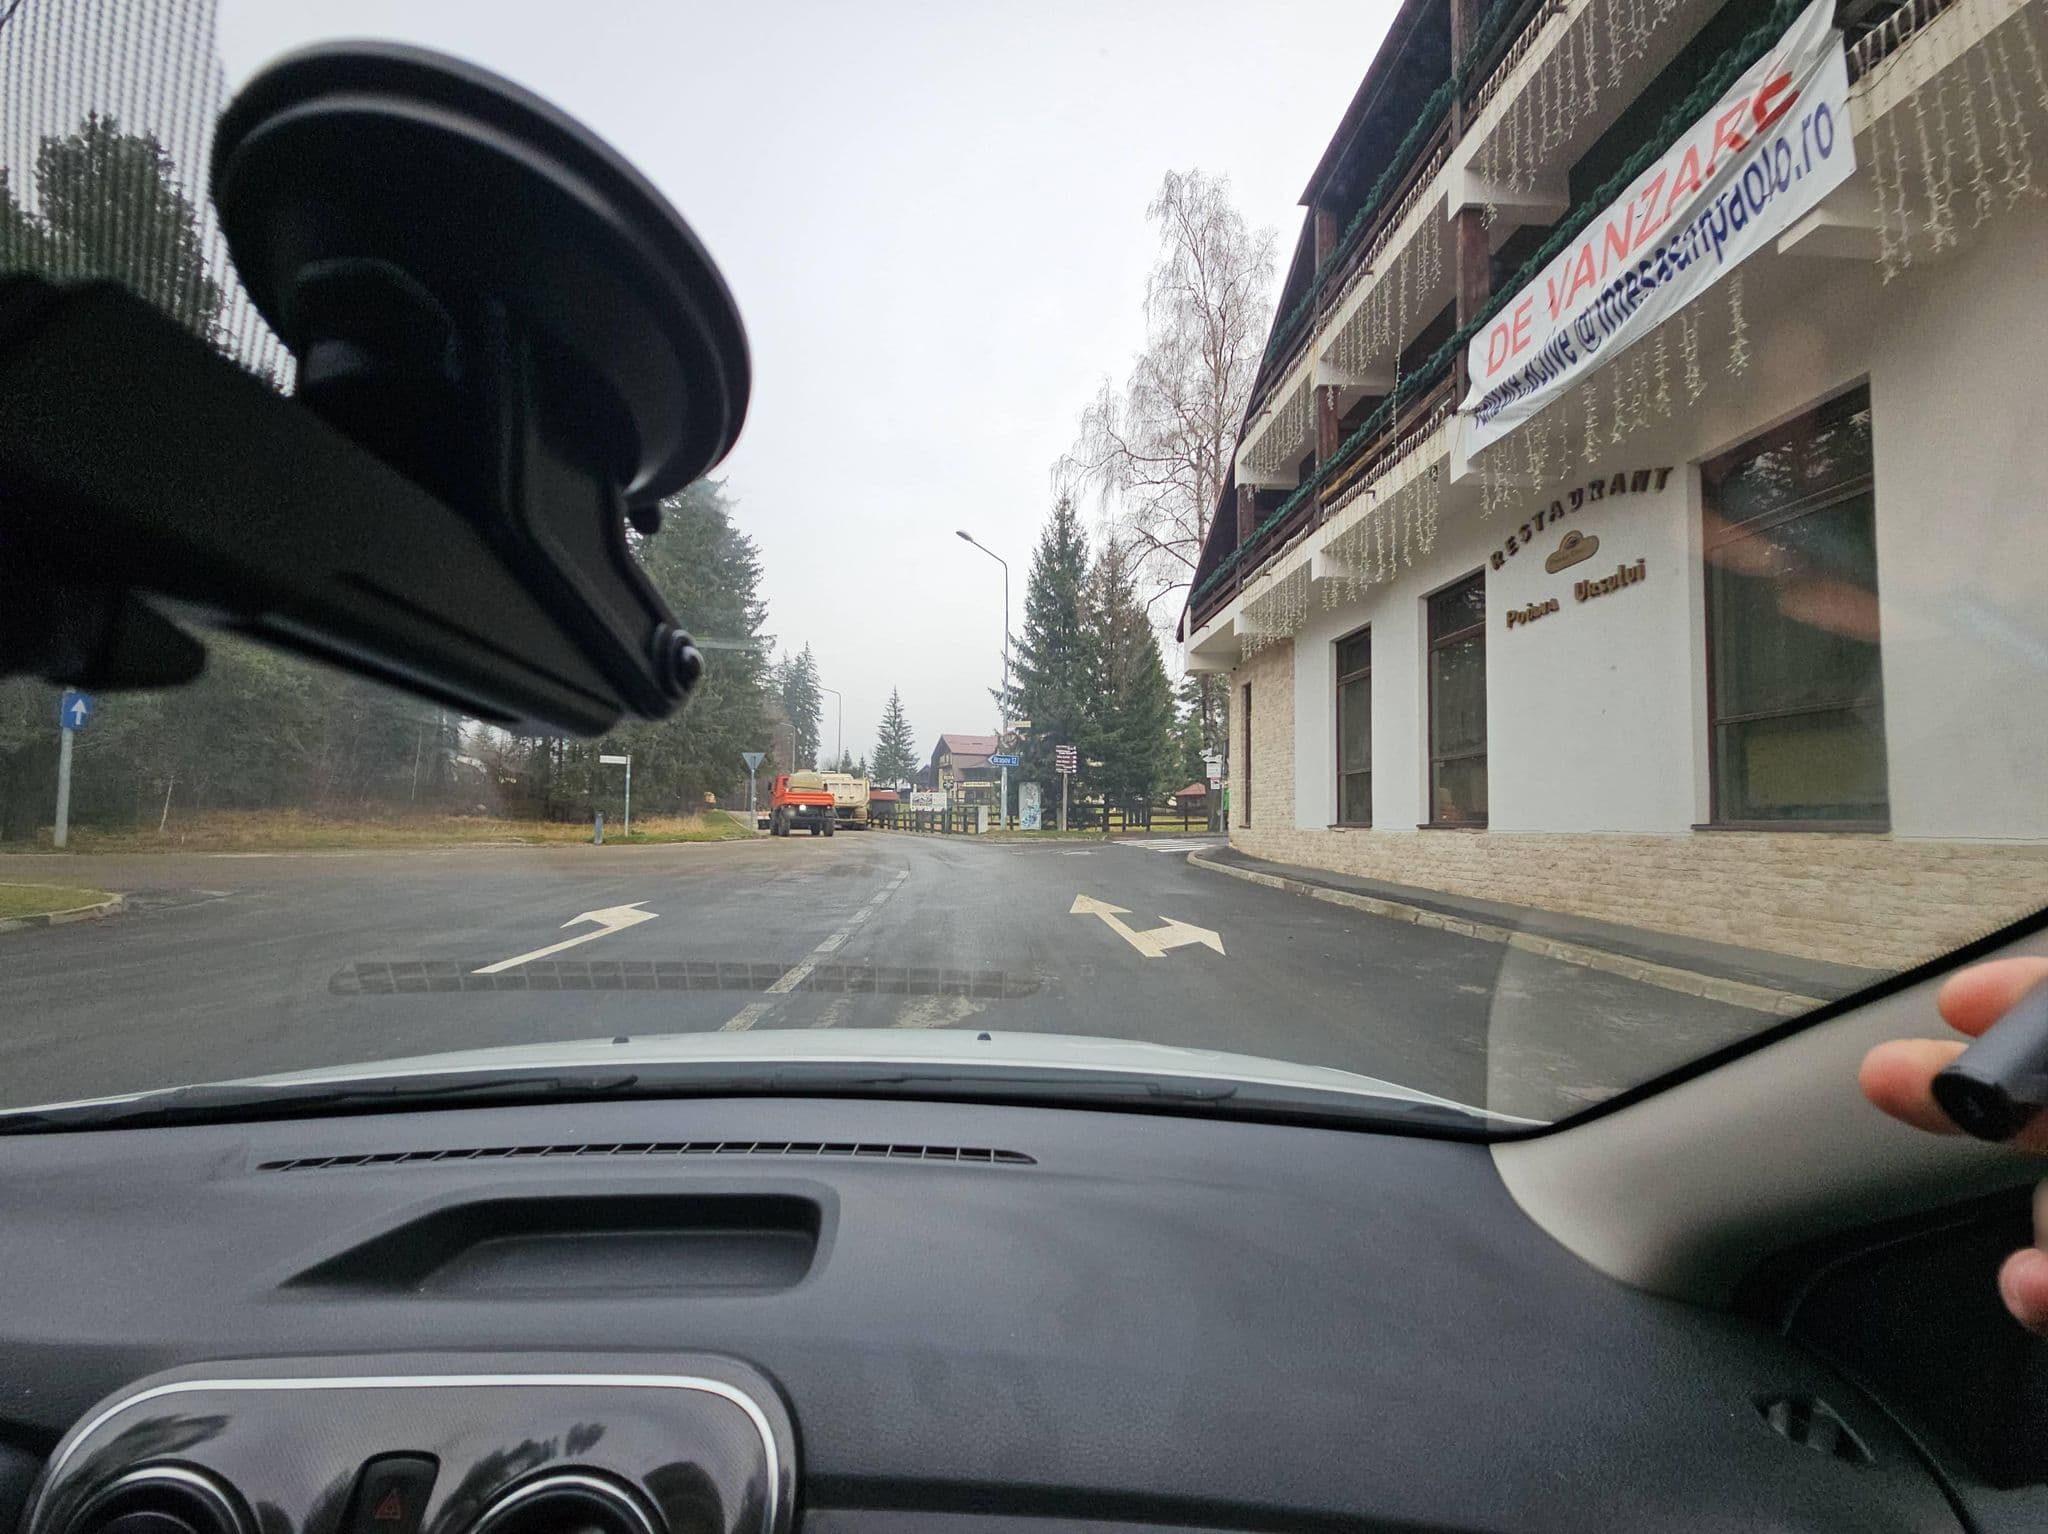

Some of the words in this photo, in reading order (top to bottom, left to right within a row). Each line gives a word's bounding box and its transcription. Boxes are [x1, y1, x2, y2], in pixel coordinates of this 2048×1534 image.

[1486, 295, 1534, 377] DE
[1545, 53, 1801, 321] VANZARE
[1490, 466, 1674, 570] RESTAURANT
